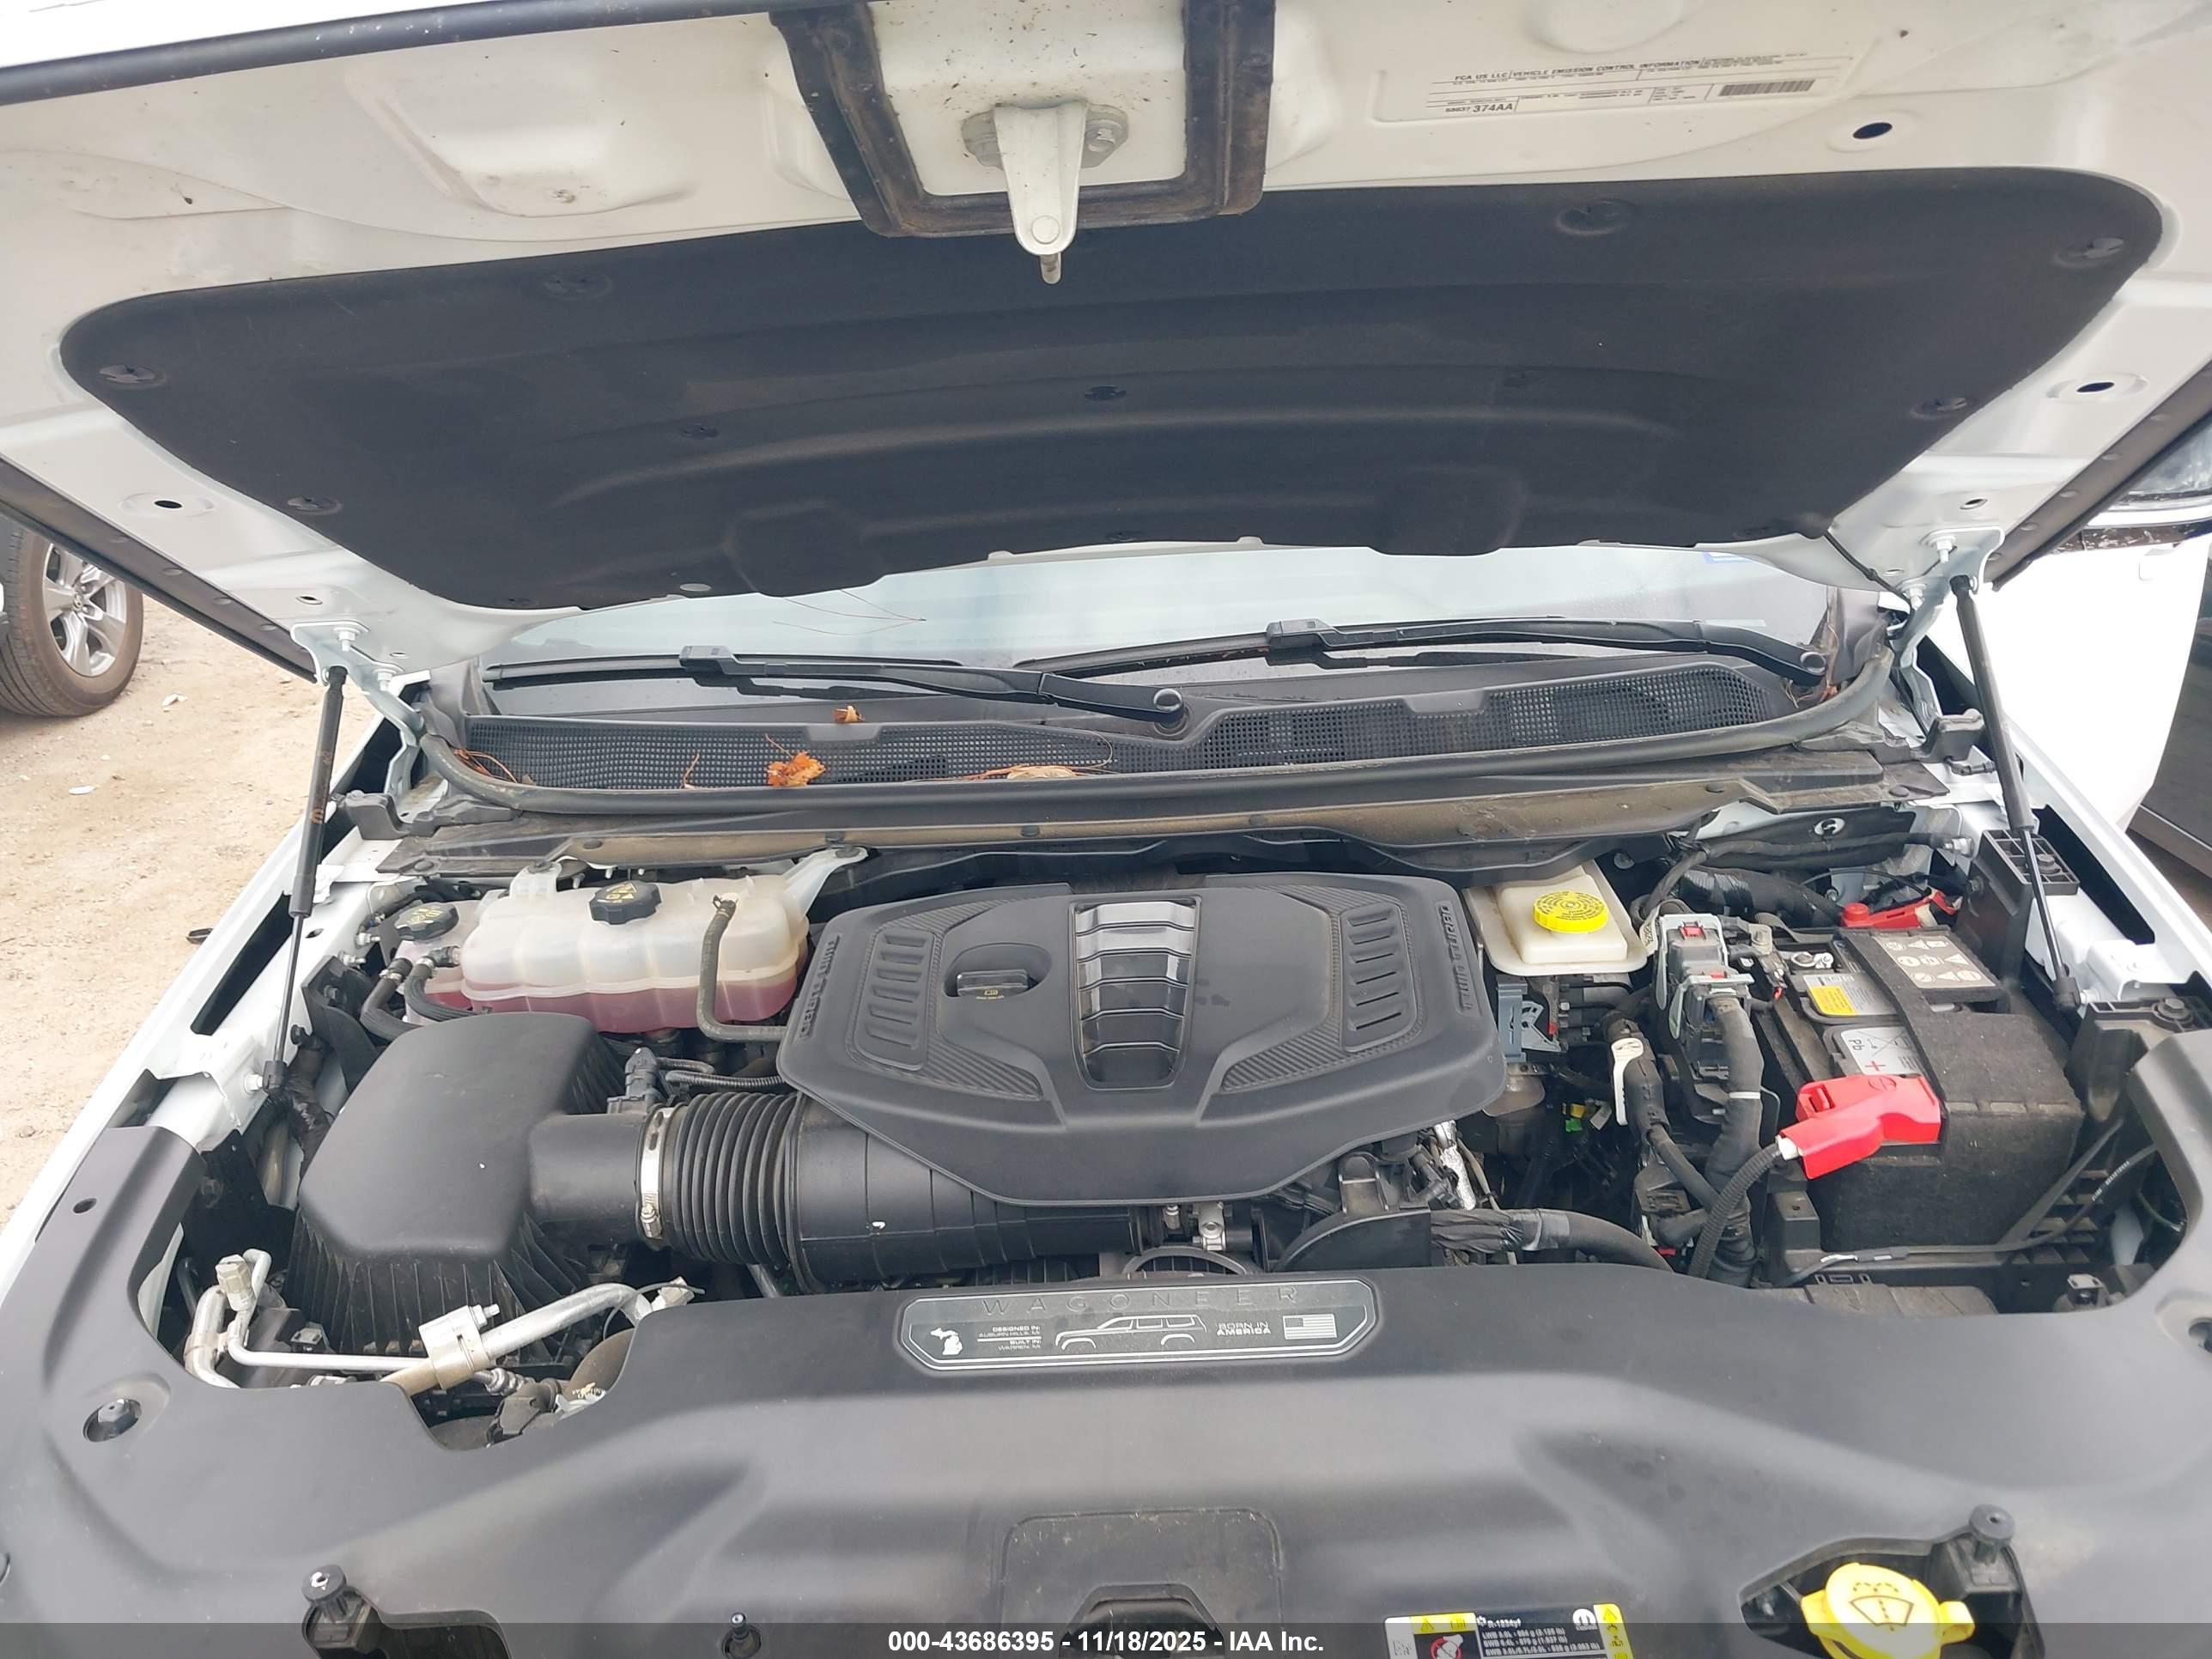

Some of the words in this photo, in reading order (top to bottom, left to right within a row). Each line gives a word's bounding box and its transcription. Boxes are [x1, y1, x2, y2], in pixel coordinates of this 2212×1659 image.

[1639, 60, 1700, 70] INFORMATION
[1473, 103, 1513, 112] 374AA
[981, 1285, 1298, 1316] WAGONEER
[1218, 1322, 1253, 1330] BORN
[1216, 1328, 1271, 1336] AMERICA
